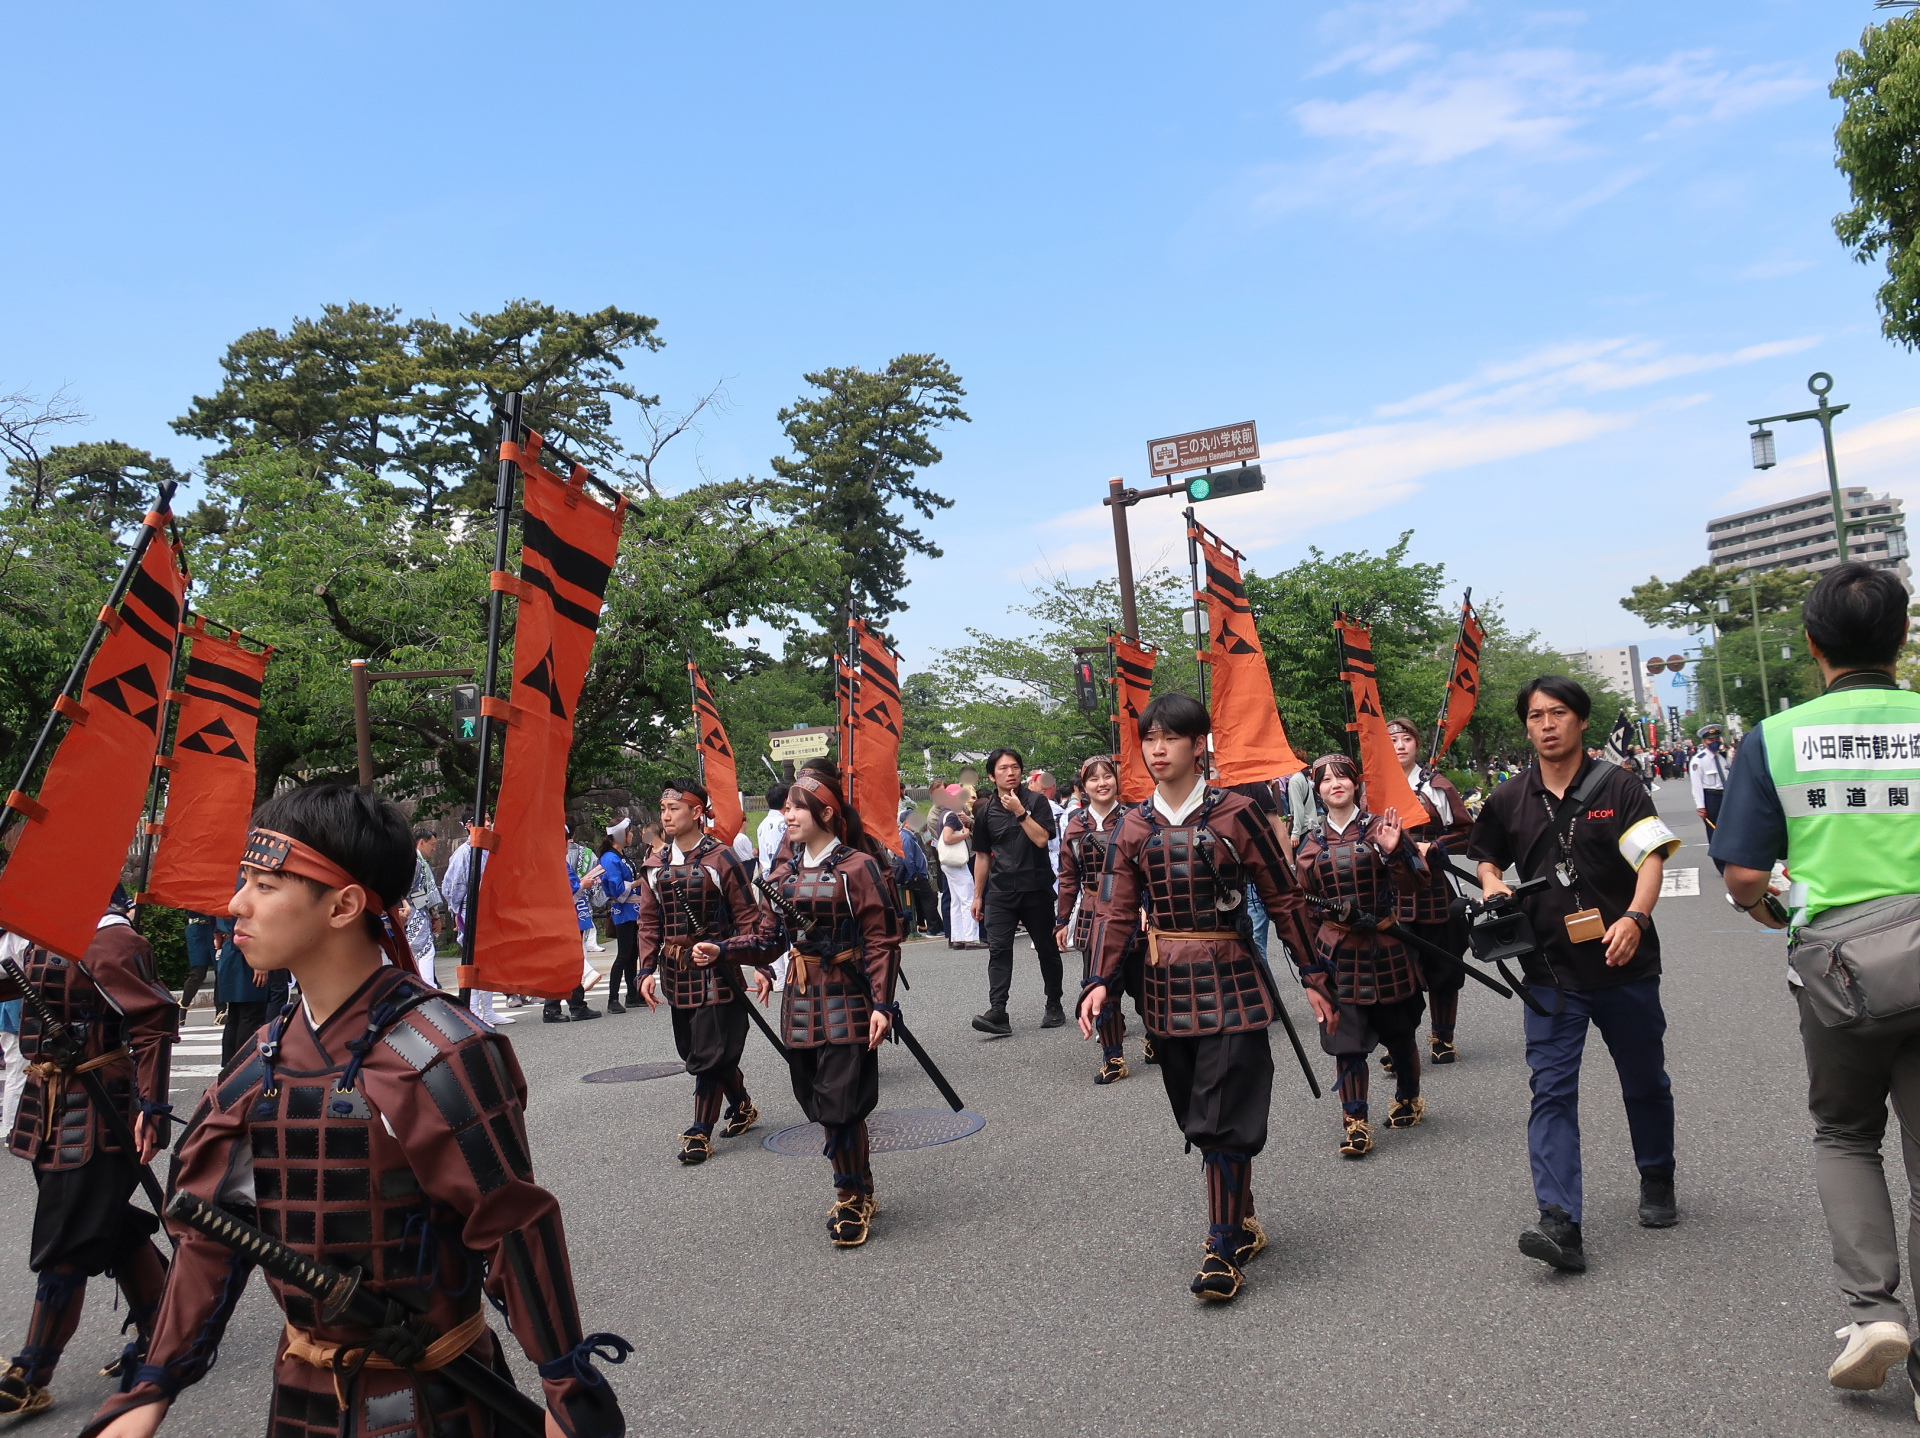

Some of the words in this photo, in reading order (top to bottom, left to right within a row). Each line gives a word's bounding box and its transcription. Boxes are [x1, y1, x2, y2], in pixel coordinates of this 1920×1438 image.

[1178, 428, 1253, 456] 三の丸小学校前
[1180, 456, 1208, 467] Sannomaru
[1209, 449, 1236, 461] Elementary
[1237, 445, 1255, 456] School
[1807, 787, 1909, 808] 報道関
[1587, 809, 1614, 820] J:COM
